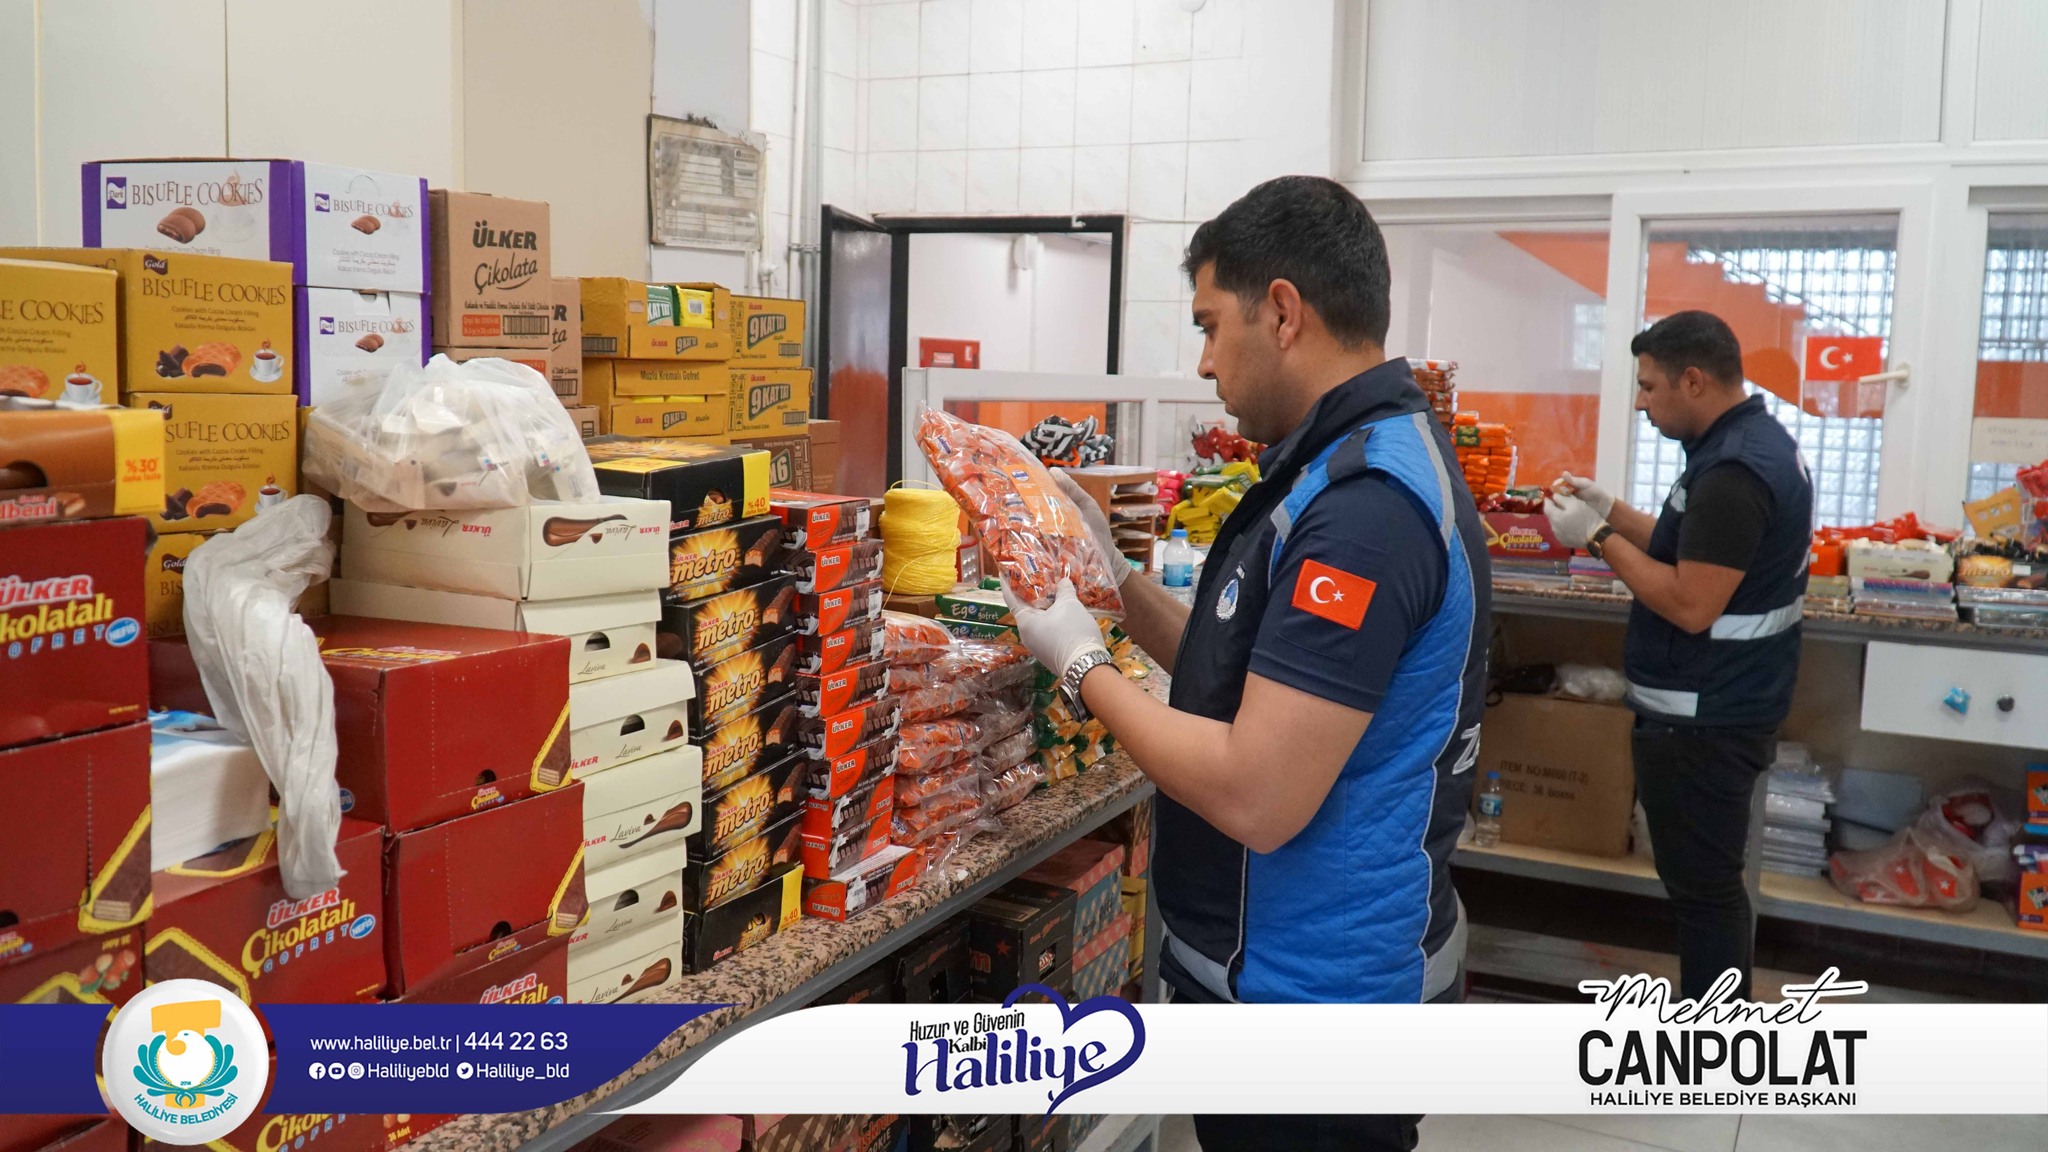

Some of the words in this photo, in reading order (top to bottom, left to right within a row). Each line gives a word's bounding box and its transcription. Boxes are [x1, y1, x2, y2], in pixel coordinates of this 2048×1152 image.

[132, 181, 193, 206] BISUFLE
[197, 178, 263, 206] COOKIES
[333, 199, 373, 215] BISUFLE
[375, 202, 413, 218] COOKIES
[472, 220, 537, 250] ÜLKER
[145, 258, 165, 269] Gold
[474, 252, 538, 295] Çikolata
[142, 278, 214, 302] BISUFLE
[218, 282, 286, 306] COOKIES
[20, 299, 104, 324] COOKIES
[338, 320, 377, 333] BISUFLE
[379, 320, 415, 333] COOKIES
[683, 370, 700, 380] Gofret
[165, 420, 218, 443] SUFLE
[222, 420, 290, 443] COOKIES
[698, 507, 730, 525] metro
[812, 512, 830, 523] ÜLKER
[420, 516, 460, 537] Laviva
[462, 523, 491, 537] ÜLKER
[639, 526, 661, 535] ÜLKER
[163, 559, 188, 569] Gold
[676, 553, 698, 563] ÜLKER
[821, 555, 840, 567] ÜLKER
[671, 548, 736, 585] metro
[824, 598, 841, 610] ÜLKER
[951, 603, 977, 619] Ege
[700, 618, 719, 628] ÜLKER
[978, 612, 999, 620] gofret
[698, 609, 755, 650] metro
[826, 636, 845, 648] ÜLKER
[708, 669, 761, 714] metro
[709, 680, 729, 692] ÜLKER
[827, 678, 847, 691] ÜLKER
[832, 720, 853, 734] ÜLKER
[706, 732, 759, 778] metro
[709, 744, 727, 756] ÜLKER
[836, 759, 855, 773] ÜLKER
[717, 791, 771, 840] metro
[720, 805, 738, 819] ÜLKER
[609, 824, 641, 843] Laviva
[709, 853, 767, 902] metro
[713, 868, 733, 882] ÜLKER
[267, 887, 340, 928] ÜLKER
[241, 898, 356, 979] Çikolatalı
[263, 923, 349, 973] GOFRET
